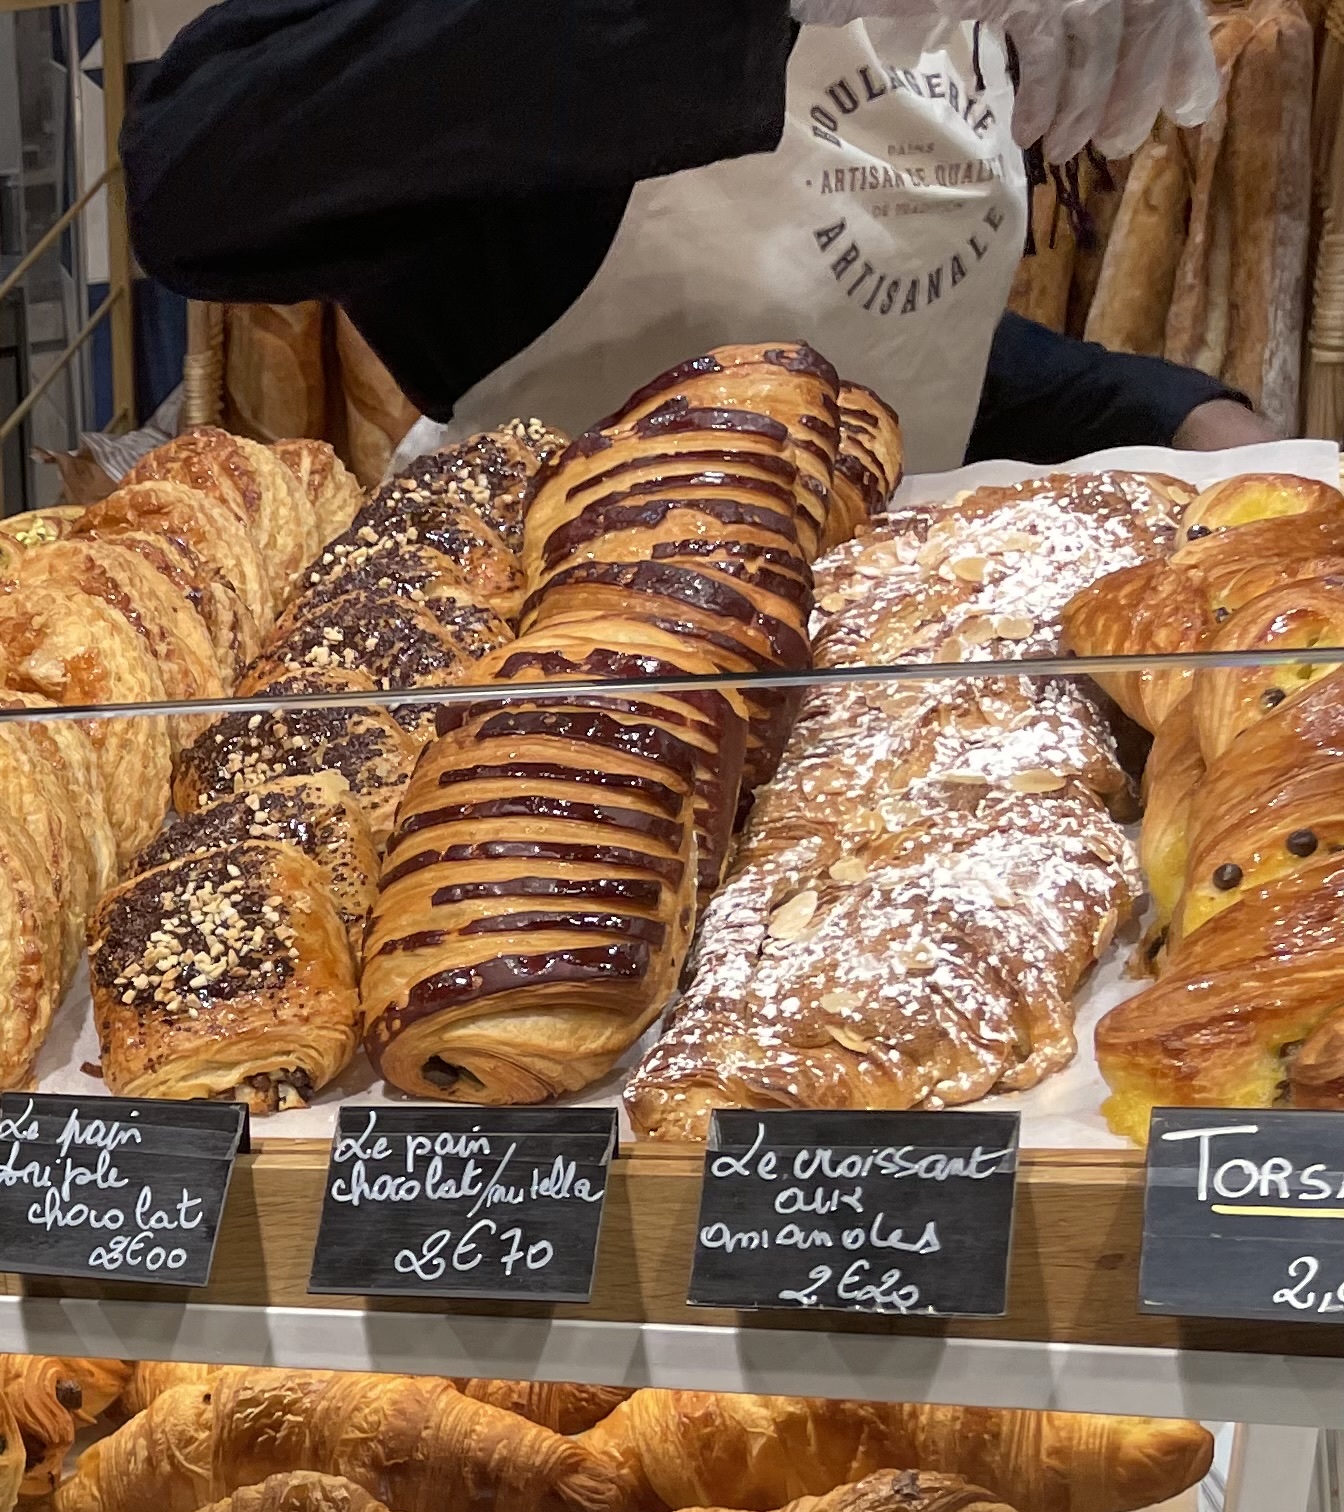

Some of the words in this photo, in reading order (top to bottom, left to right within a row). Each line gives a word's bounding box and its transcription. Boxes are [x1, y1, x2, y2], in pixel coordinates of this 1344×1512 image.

[813, 205, 1005, 316] ARTISANALE
[55, 1107, 143, 1158] pain
[332, 1110, 393, 1163] Le
[404, 1125, 491, 1173] pain
[710, 1121, 779, 1180] Le
[1160, 1123, 1344, 1202] TORS
[26, 1184, 205, 1232] chocolat
[774, 1185, 865, 1215] aux
[393, 1217, 555, 1282] 2€70
[699, 1211, 943, 1255] amandes
